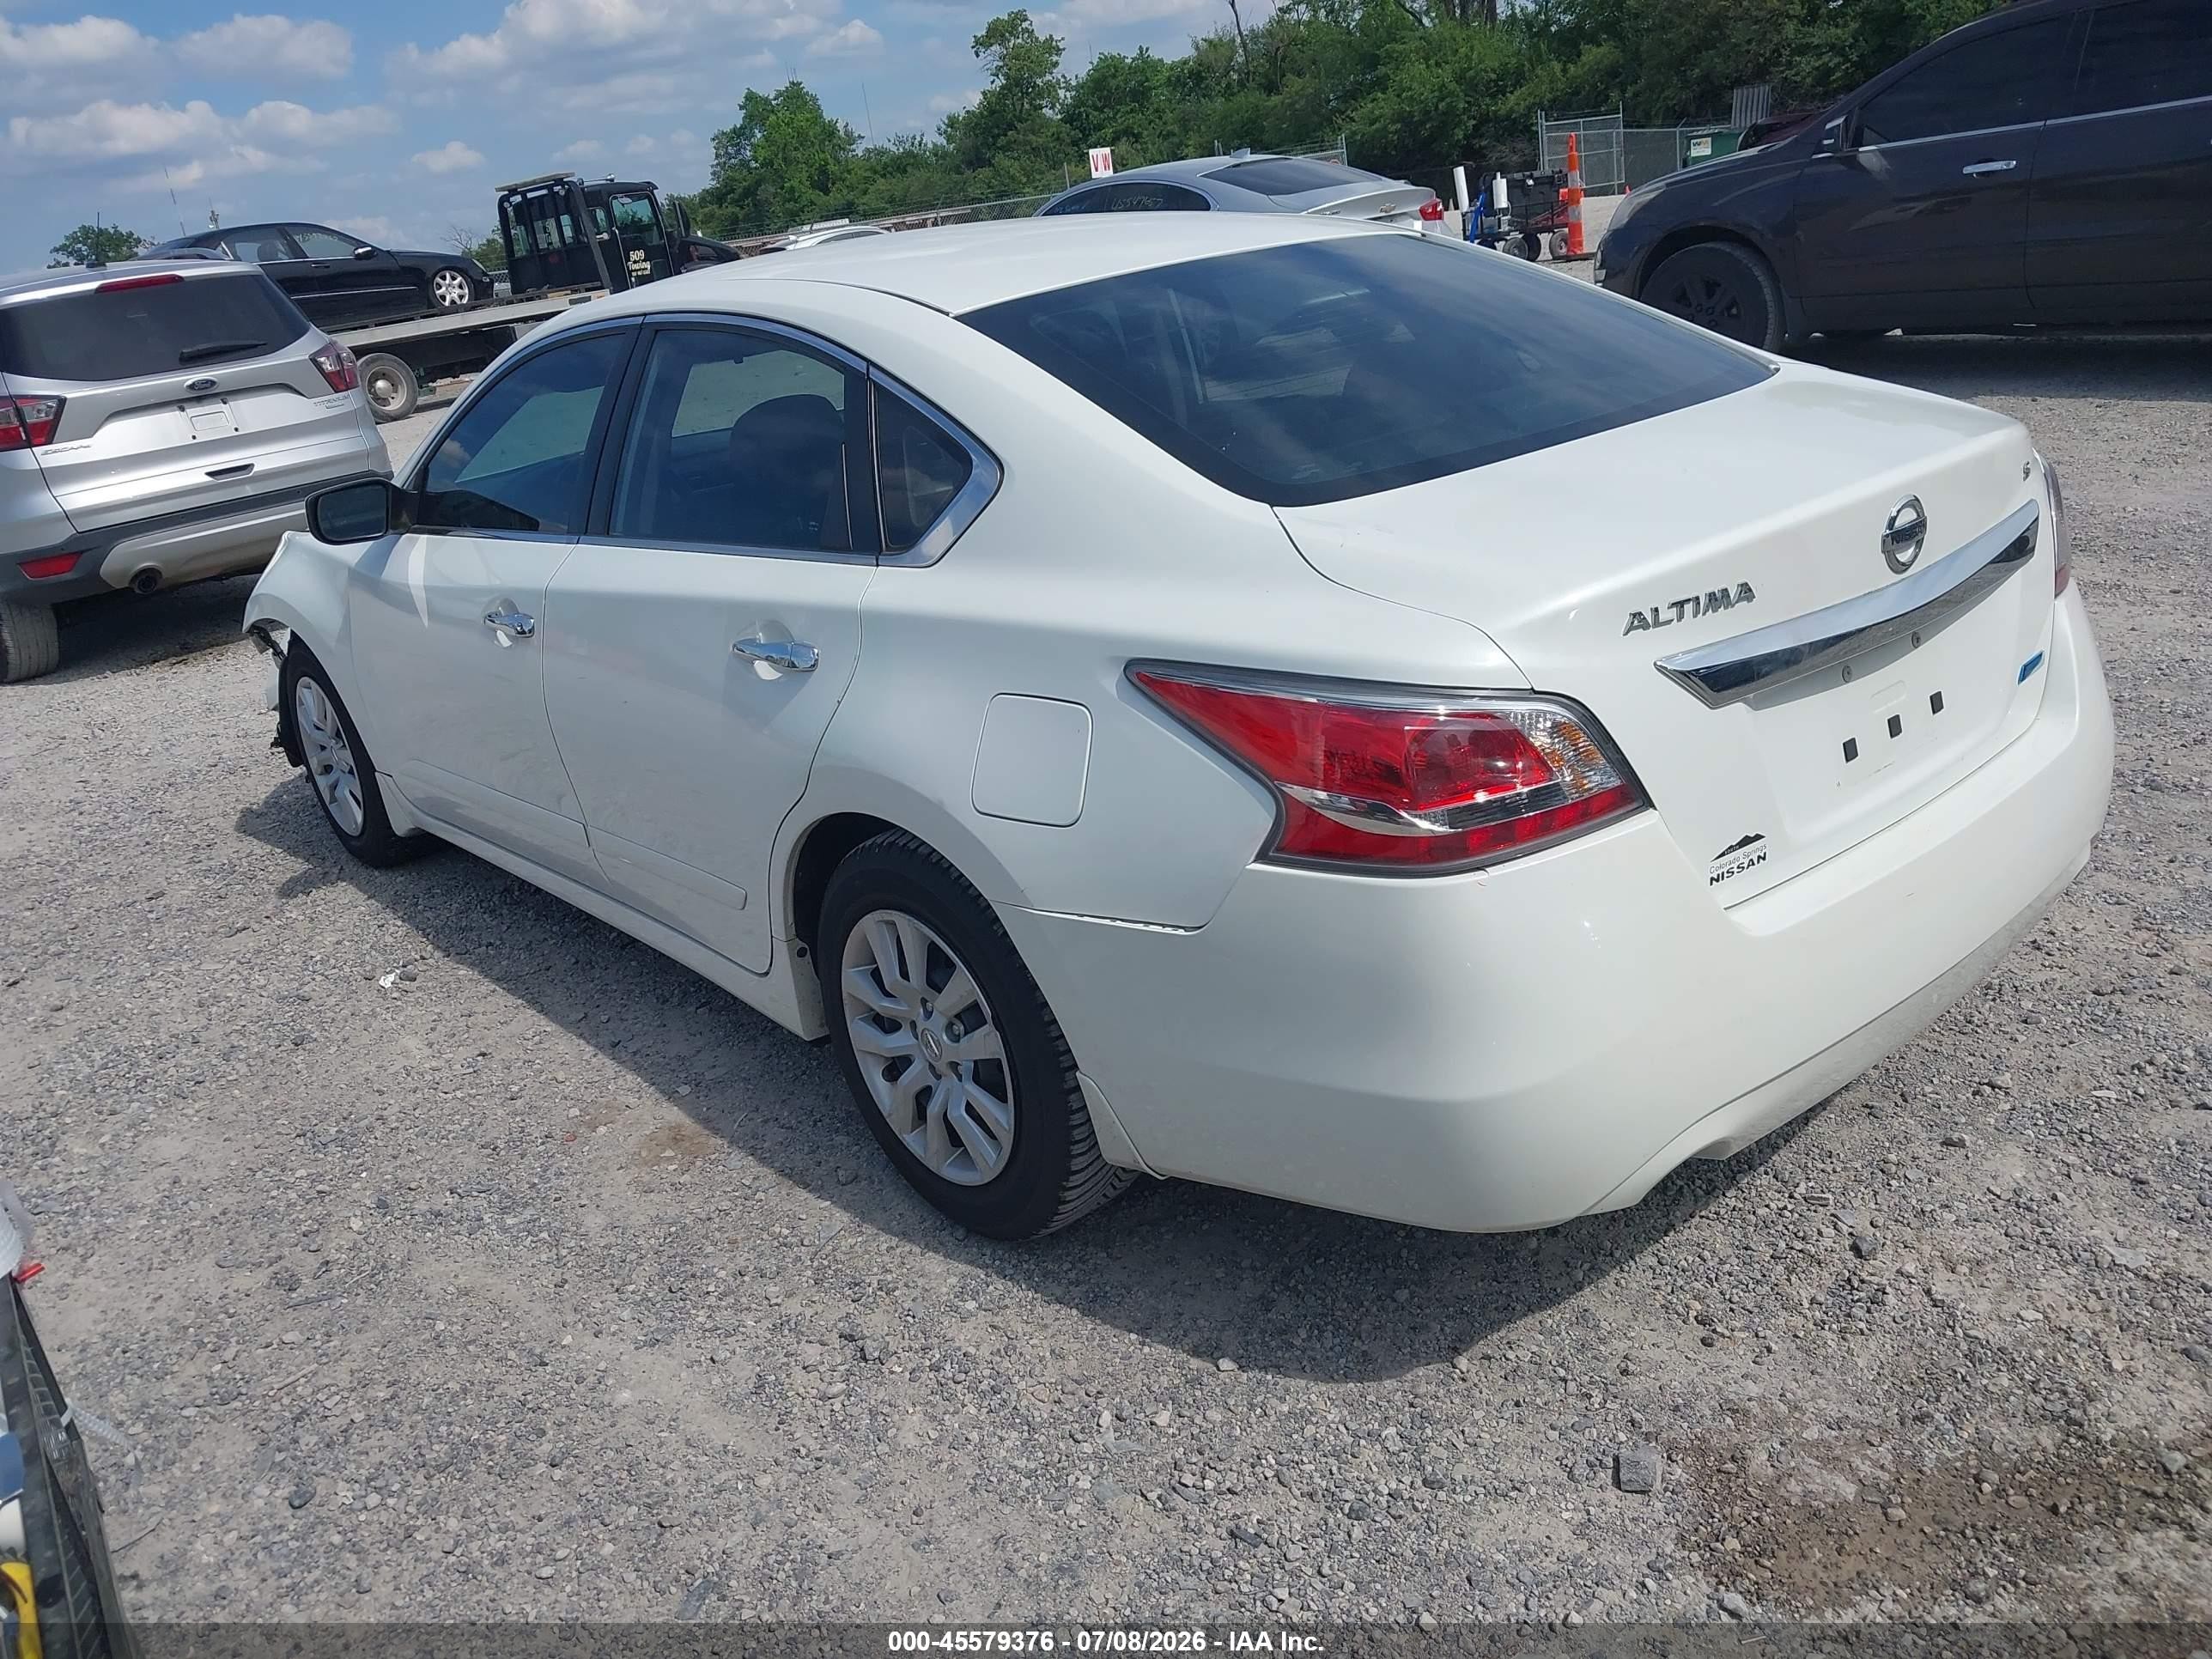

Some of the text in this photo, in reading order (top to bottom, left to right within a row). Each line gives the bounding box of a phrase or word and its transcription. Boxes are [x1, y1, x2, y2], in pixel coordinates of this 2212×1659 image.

[627, 261, 651, 270] Towing
[629, 249, 645, 261] 509
[1622, 581, 1757, 636] ALTIMA
[1709, 843, 1767, 874] Colorado Springs
[1709, 851, 1767, 886] NISSAN
